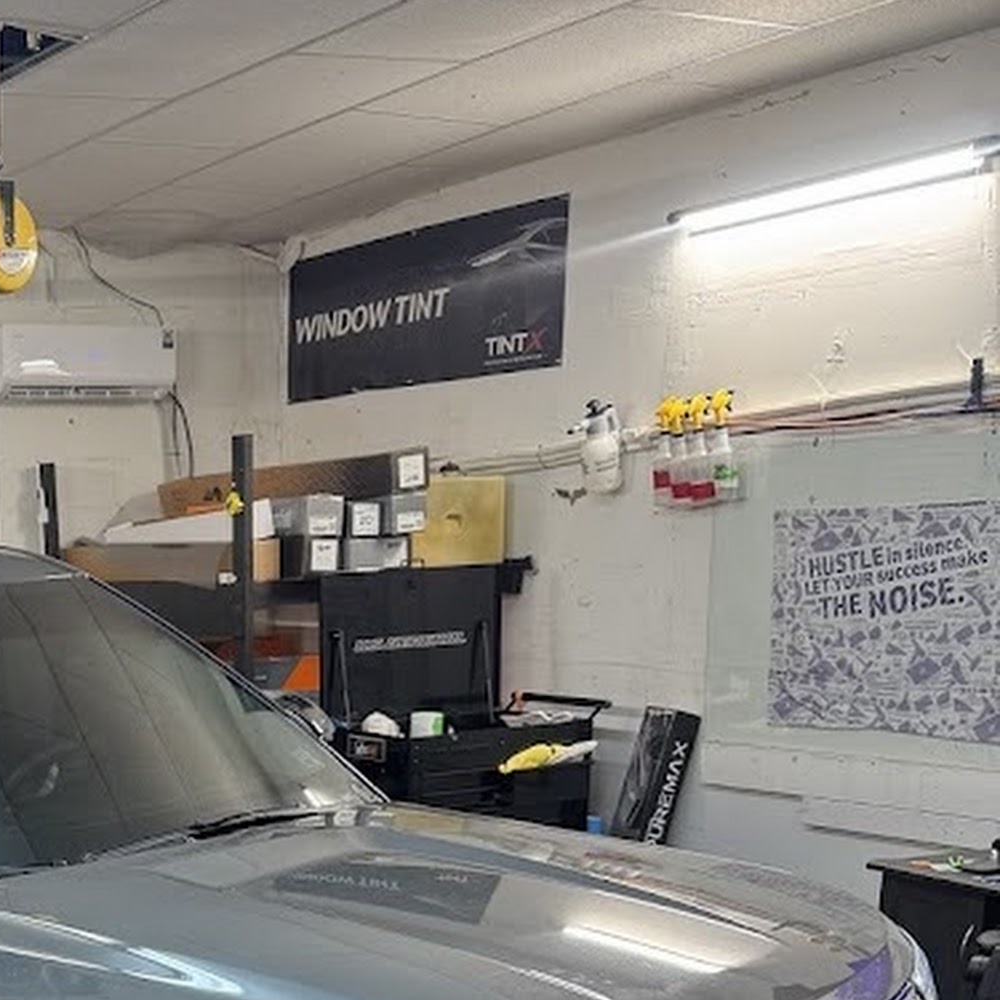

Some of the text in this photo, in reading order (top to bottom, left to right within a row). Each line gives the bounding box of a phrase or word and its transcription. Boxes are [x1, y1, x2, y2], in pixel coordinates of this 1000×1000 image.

[296, 287, 450, 345] WINDOW TINT
[485, 327, 548, 356] TINTX
[804, 551, 989, 596] LET YOUR success make
[808, 546, 884, 578] HUSTLE
[887, 548, 901, 565] in
[819, 577, 965, 619] THE NOISE.
